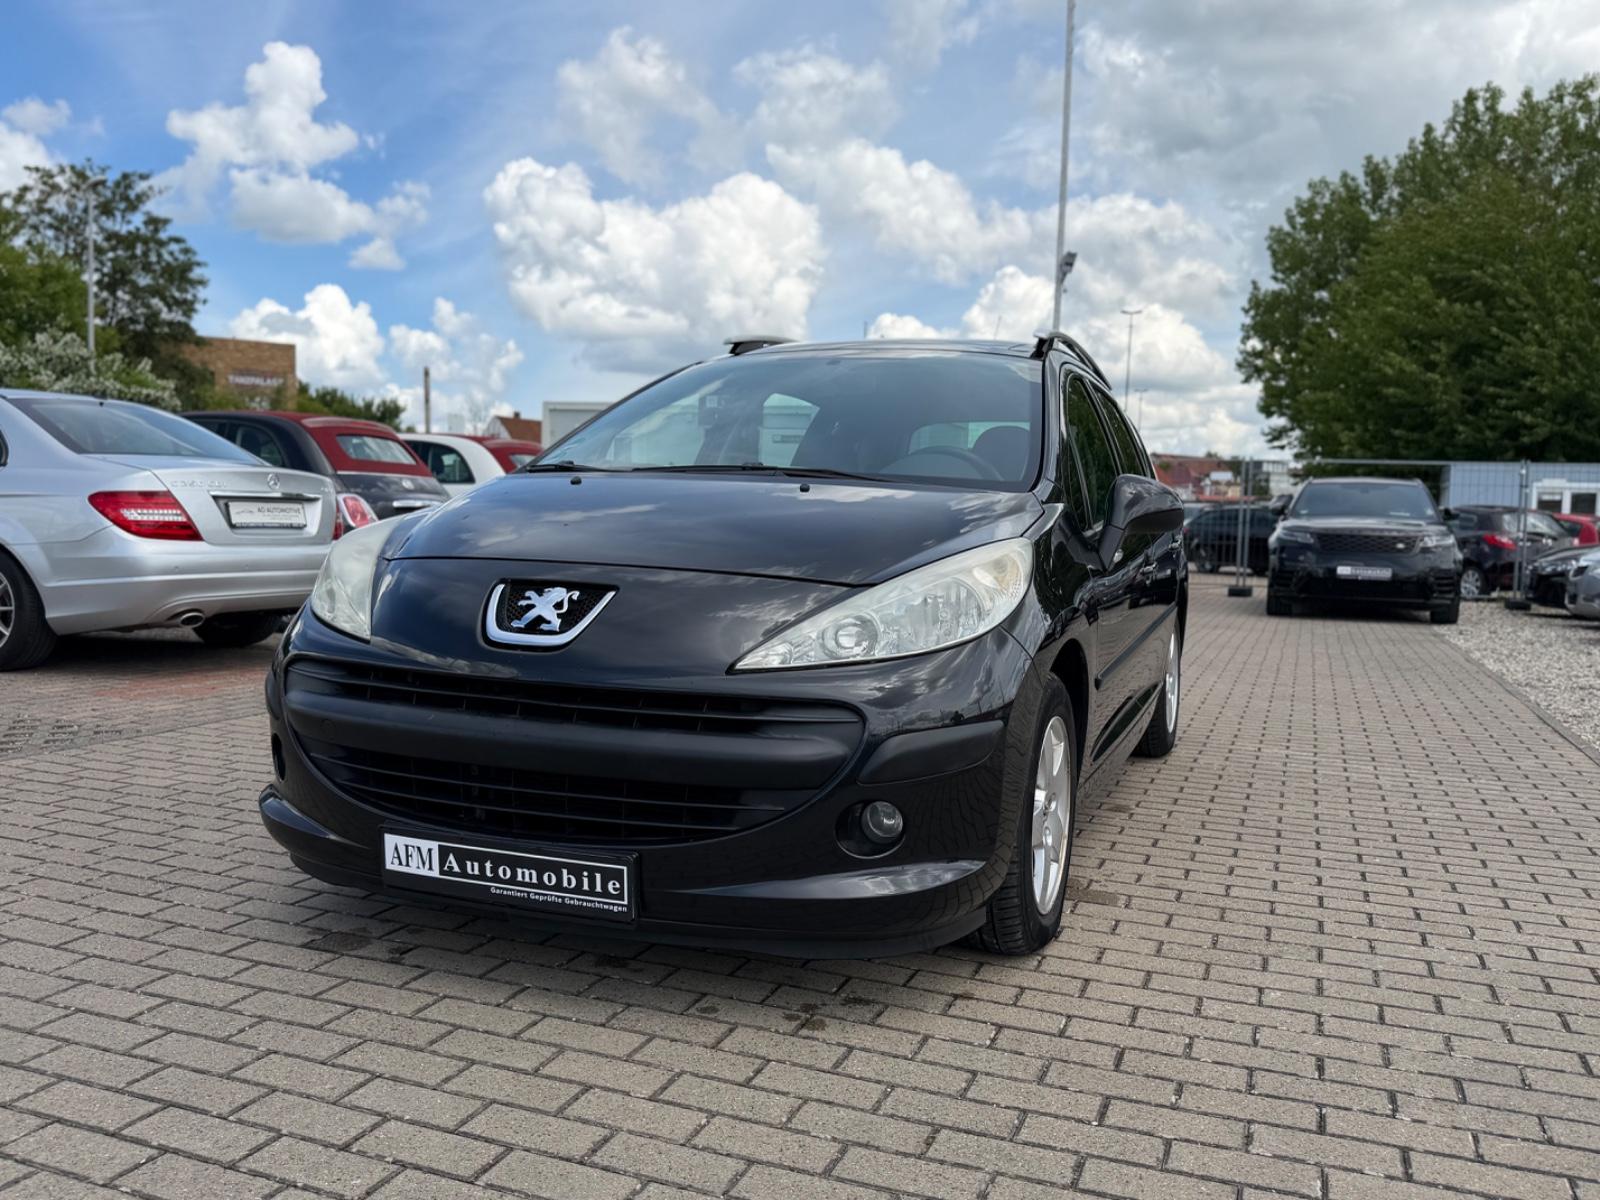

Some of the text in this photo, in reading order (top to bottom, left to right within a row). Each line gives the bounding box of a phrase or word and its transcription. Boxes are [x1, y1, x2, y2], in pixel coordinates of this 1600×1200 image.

[390, 842, 621, 895] AFM Automobile
[490, 886, 628, 912] Garantiert Geprüfte Gebrauchtwagen
